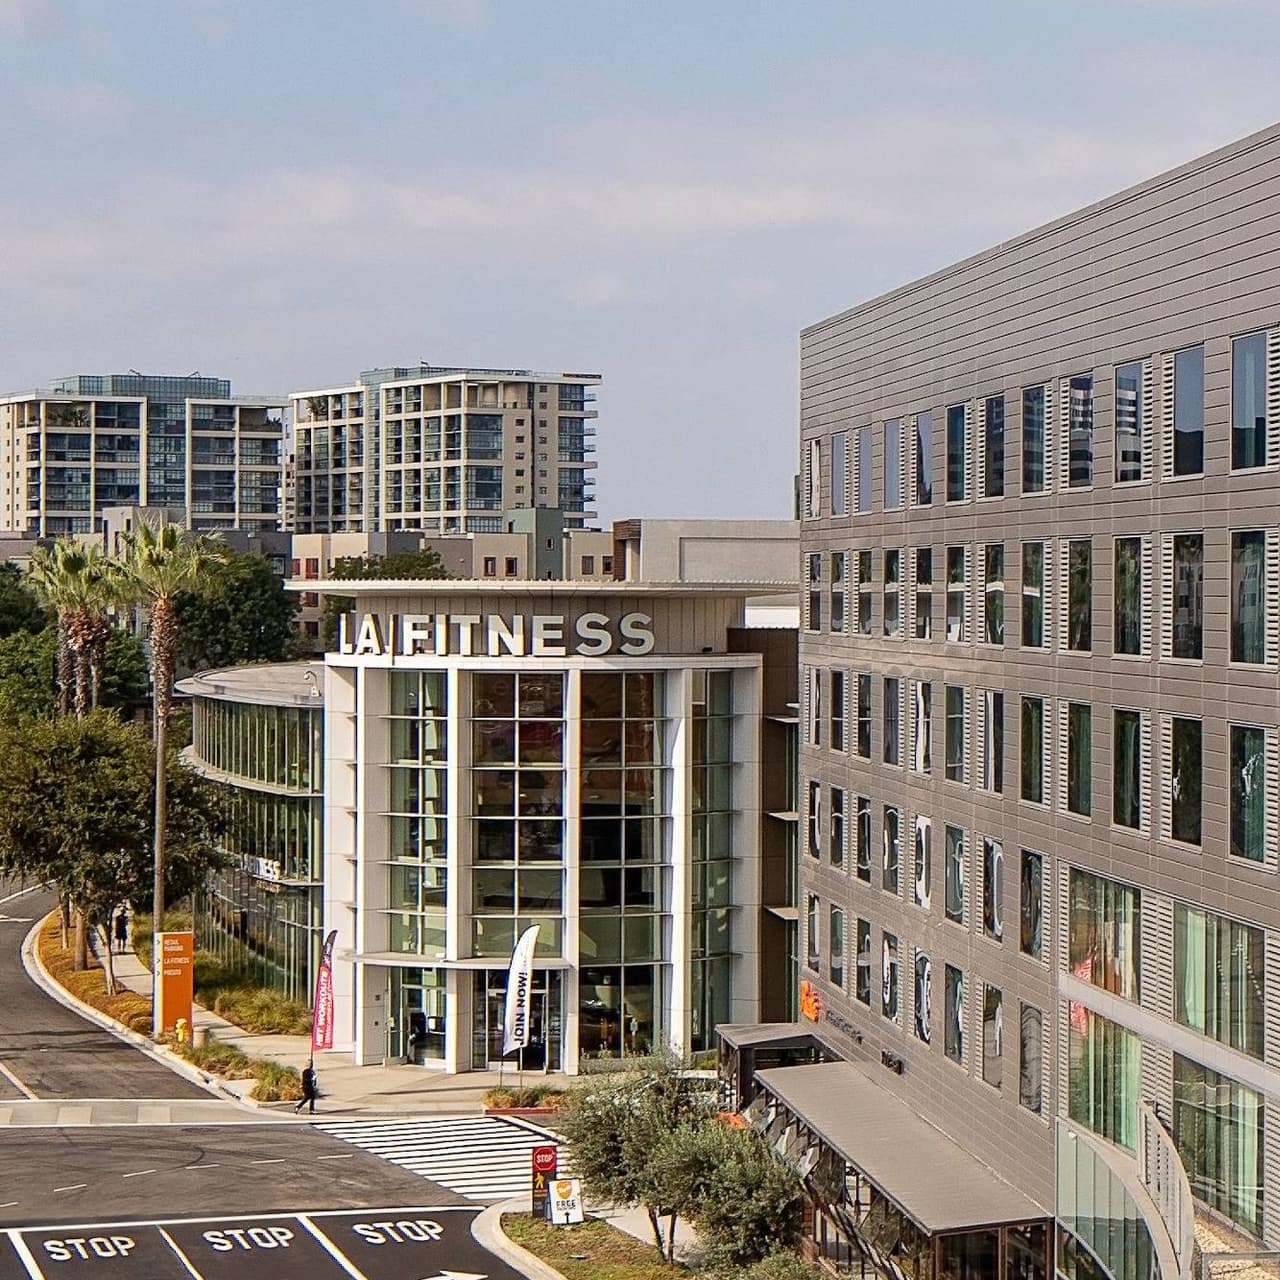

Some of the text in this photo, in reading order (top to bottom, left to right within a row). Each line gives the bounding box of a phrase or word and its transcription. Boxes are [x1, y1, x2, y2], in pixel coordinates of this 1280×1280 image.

[401, 611, 655, 657] FITNESS
[514, 972, 528, 1046] JOIN NOW!
[536, 1154, 553, 1163] STOP
[202, 1226, 295, 1251] STOP
[352, 1220, 445, 1245] STOP
[43, 1236, 136, 1261] STOP
